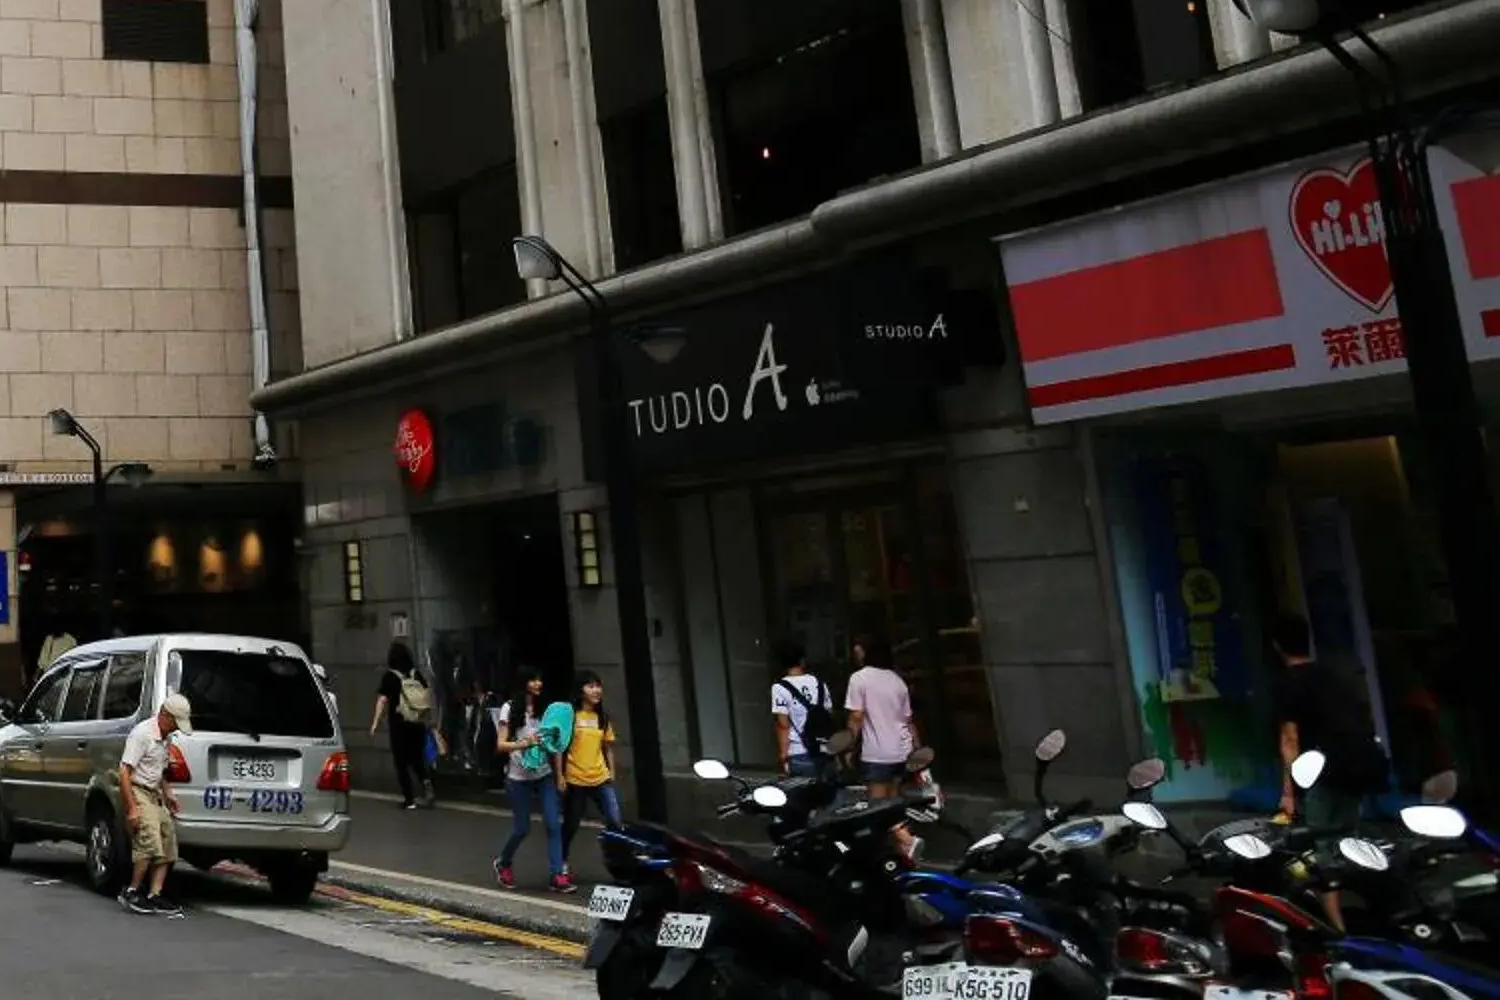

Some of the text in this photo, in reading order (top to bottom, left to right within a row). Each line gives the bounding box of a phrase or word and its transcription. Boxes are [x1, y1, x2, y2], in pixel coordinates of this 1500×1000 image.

[864, 313, 948, 339] STUDIO A
[1321, 317, 1407, 369] 萊爾
[627, 322, 788, 438] TUDIO A
[203, 785, 304, 814] 6E-4293
